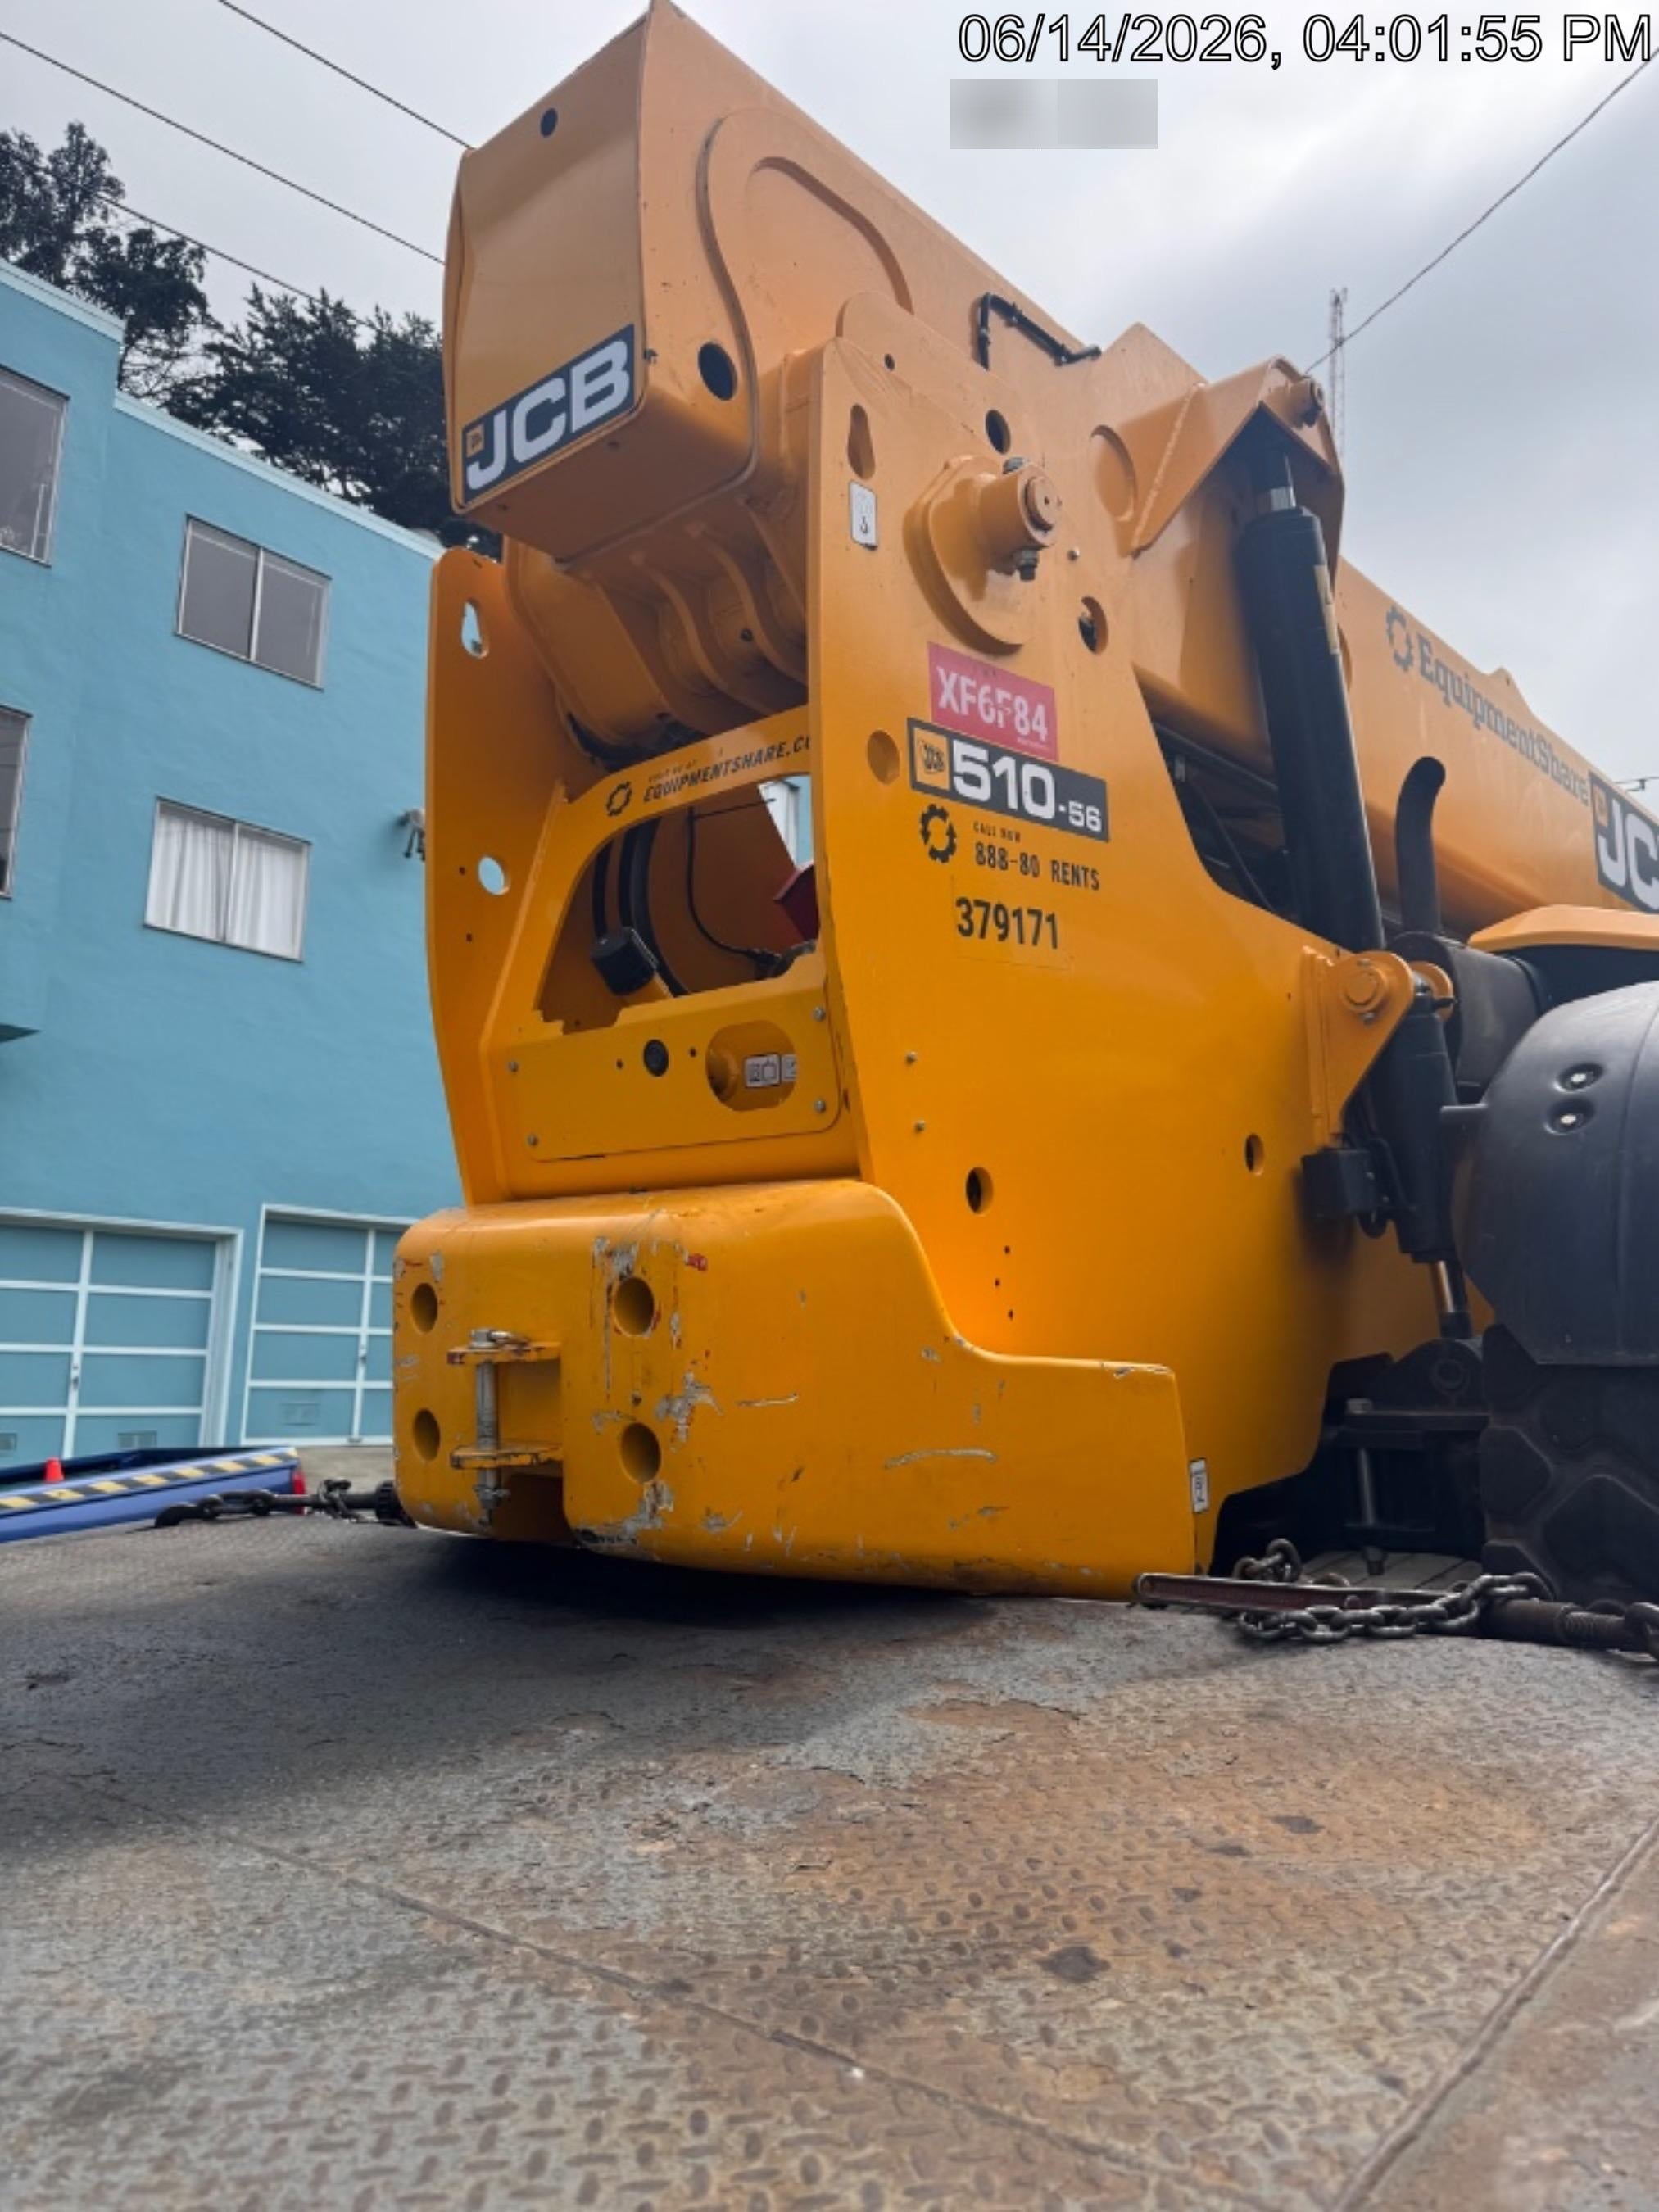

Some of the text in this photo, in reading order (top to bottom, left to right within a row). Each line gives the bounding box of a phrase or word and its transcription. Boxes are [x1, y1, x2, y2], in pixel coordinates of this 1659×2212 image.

[465, 340, 630, 490] JCB
[1417, 631, 1589, 807] EquipmentShare
[975, 841, 1100, 891] 888-80 RENTS
[1598, 797, 1659, 911] JC
[955, 896, 1058, 950] 379171
